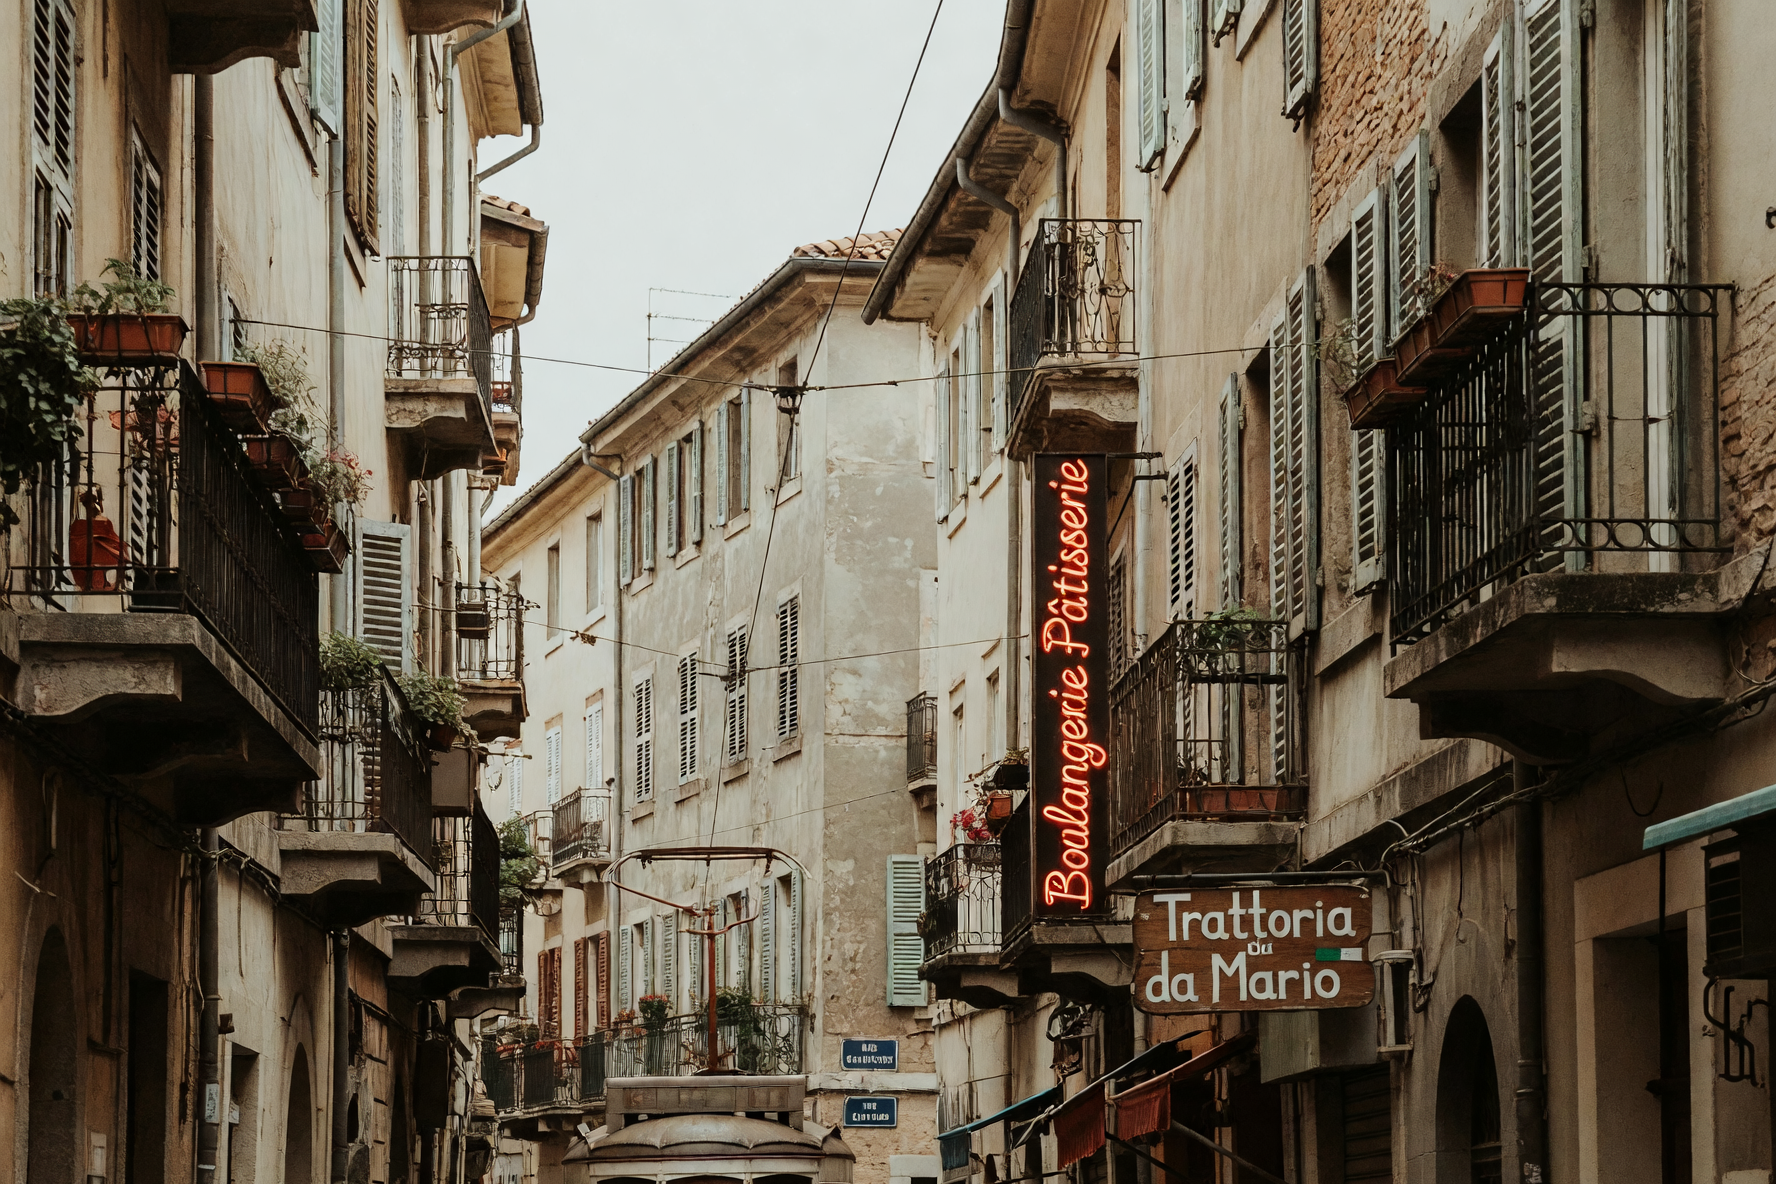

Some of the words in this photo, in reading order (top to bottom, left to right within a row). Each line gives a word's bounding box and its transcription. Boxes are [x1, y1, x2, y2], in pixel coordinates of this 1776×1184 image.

[1042, 458, 1089, 658] Pâtisserie
[1042, 665, 1107, 909] Boulangerie
[1145, 950, 1199, 1003] da
[1211, 951, 1341, 1004] Mario
[1153, 890, 1356, 941] Trattoria
